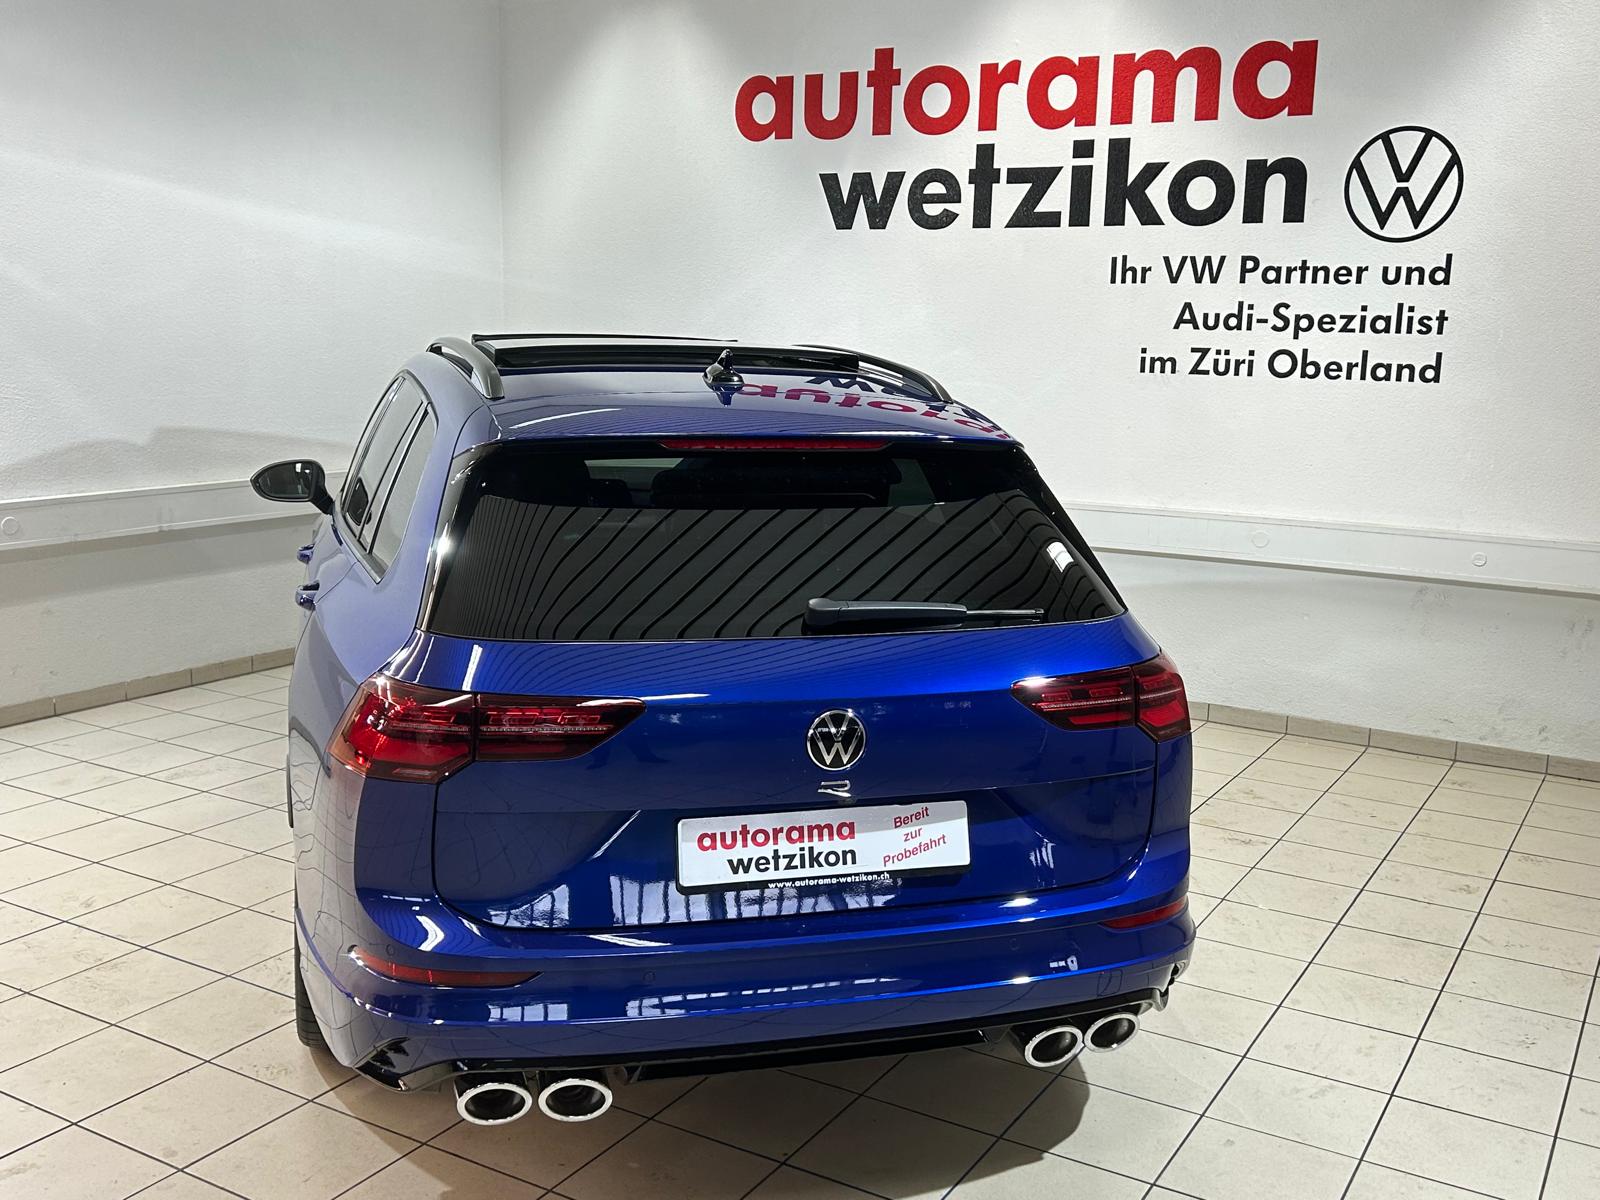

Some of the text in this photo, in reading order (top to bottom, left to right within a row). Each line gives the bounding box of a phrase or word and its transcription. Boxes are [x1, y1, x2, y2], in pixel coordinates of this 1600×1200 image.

[735, 40, 1318, 142] autorama
[819, 137, 1308, 231] wetzikon
[1110, 253, 1453, 286] Ihr VW Partner und
[1173, 300, 1449, 340] Audi-Spezialist
[1139, 347, 1443, 384] im Züri Oberland
[893, 806, 930, 829] Bereit
[903, 826, 923, 842] zur
[696, 821, 857, 852] autorama
[882, 834, 947, 867] Probefahrt
[726, 846, 858, 875] wetzikon
[767, 871, 890, 889] www.autorama-wetzikon.ch
